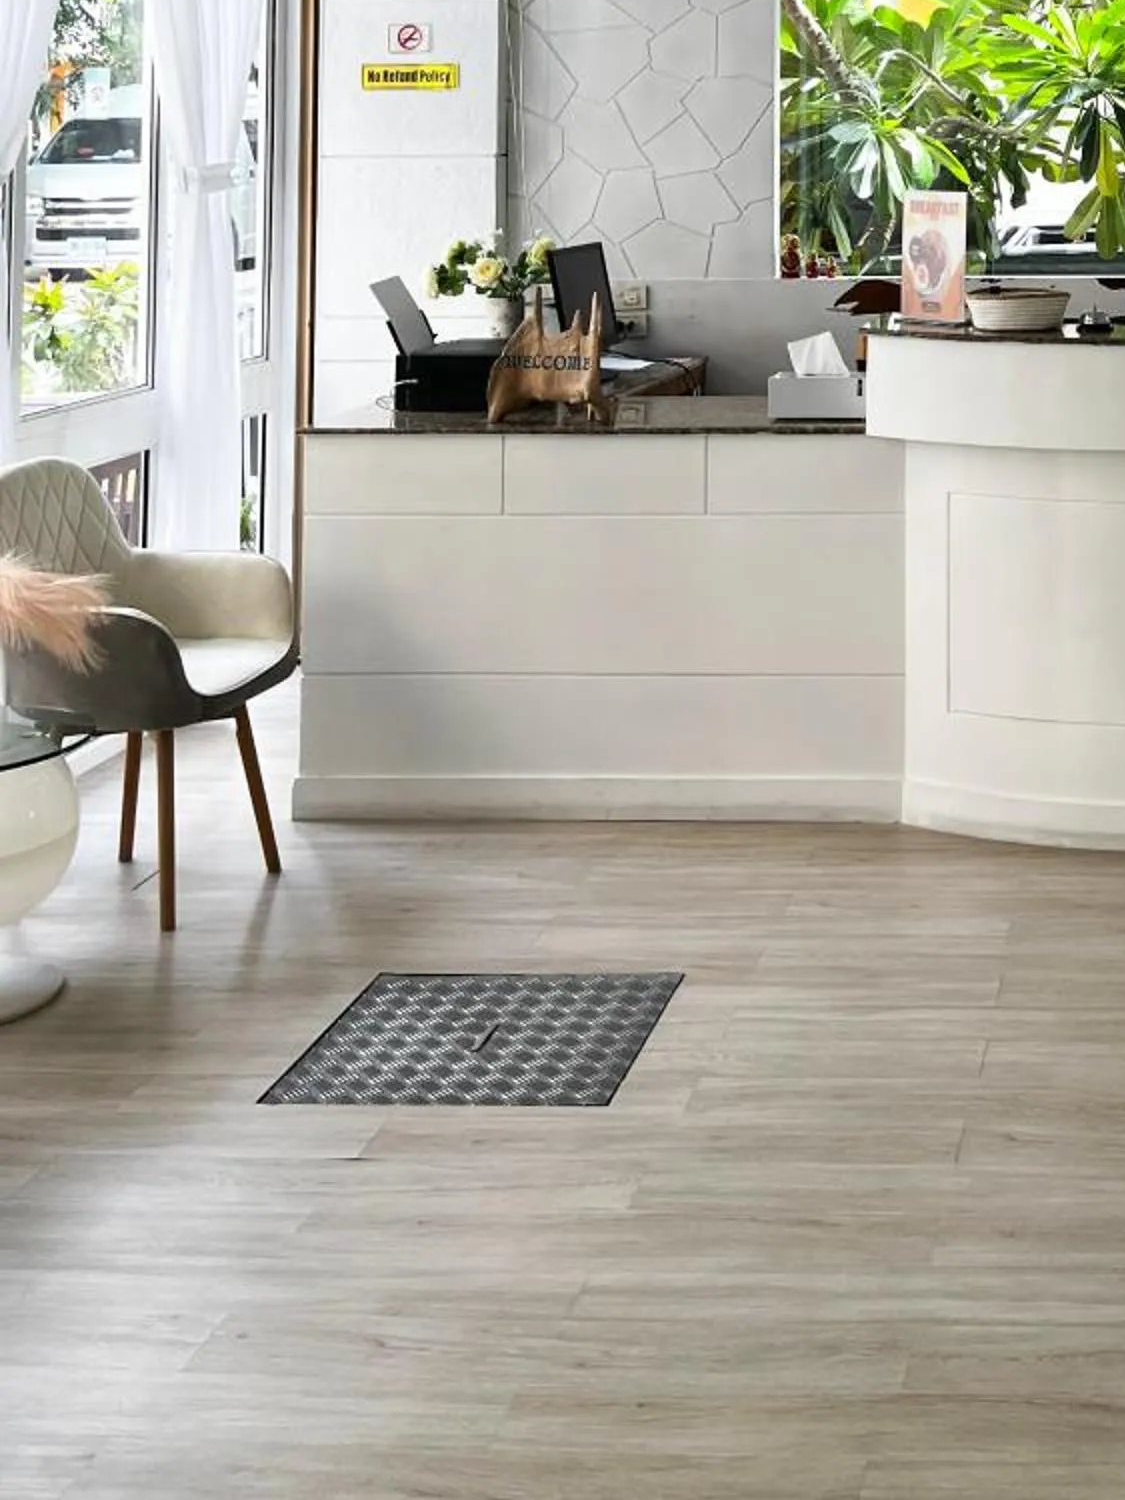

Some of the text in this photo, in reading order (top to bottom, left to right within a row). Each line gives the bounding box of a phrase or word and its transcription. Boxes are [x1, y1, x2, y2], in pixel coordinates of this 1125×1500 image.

[367, 69, 451, 85] No Refund Policy
[503, 355, 592, 371] WELCOME
